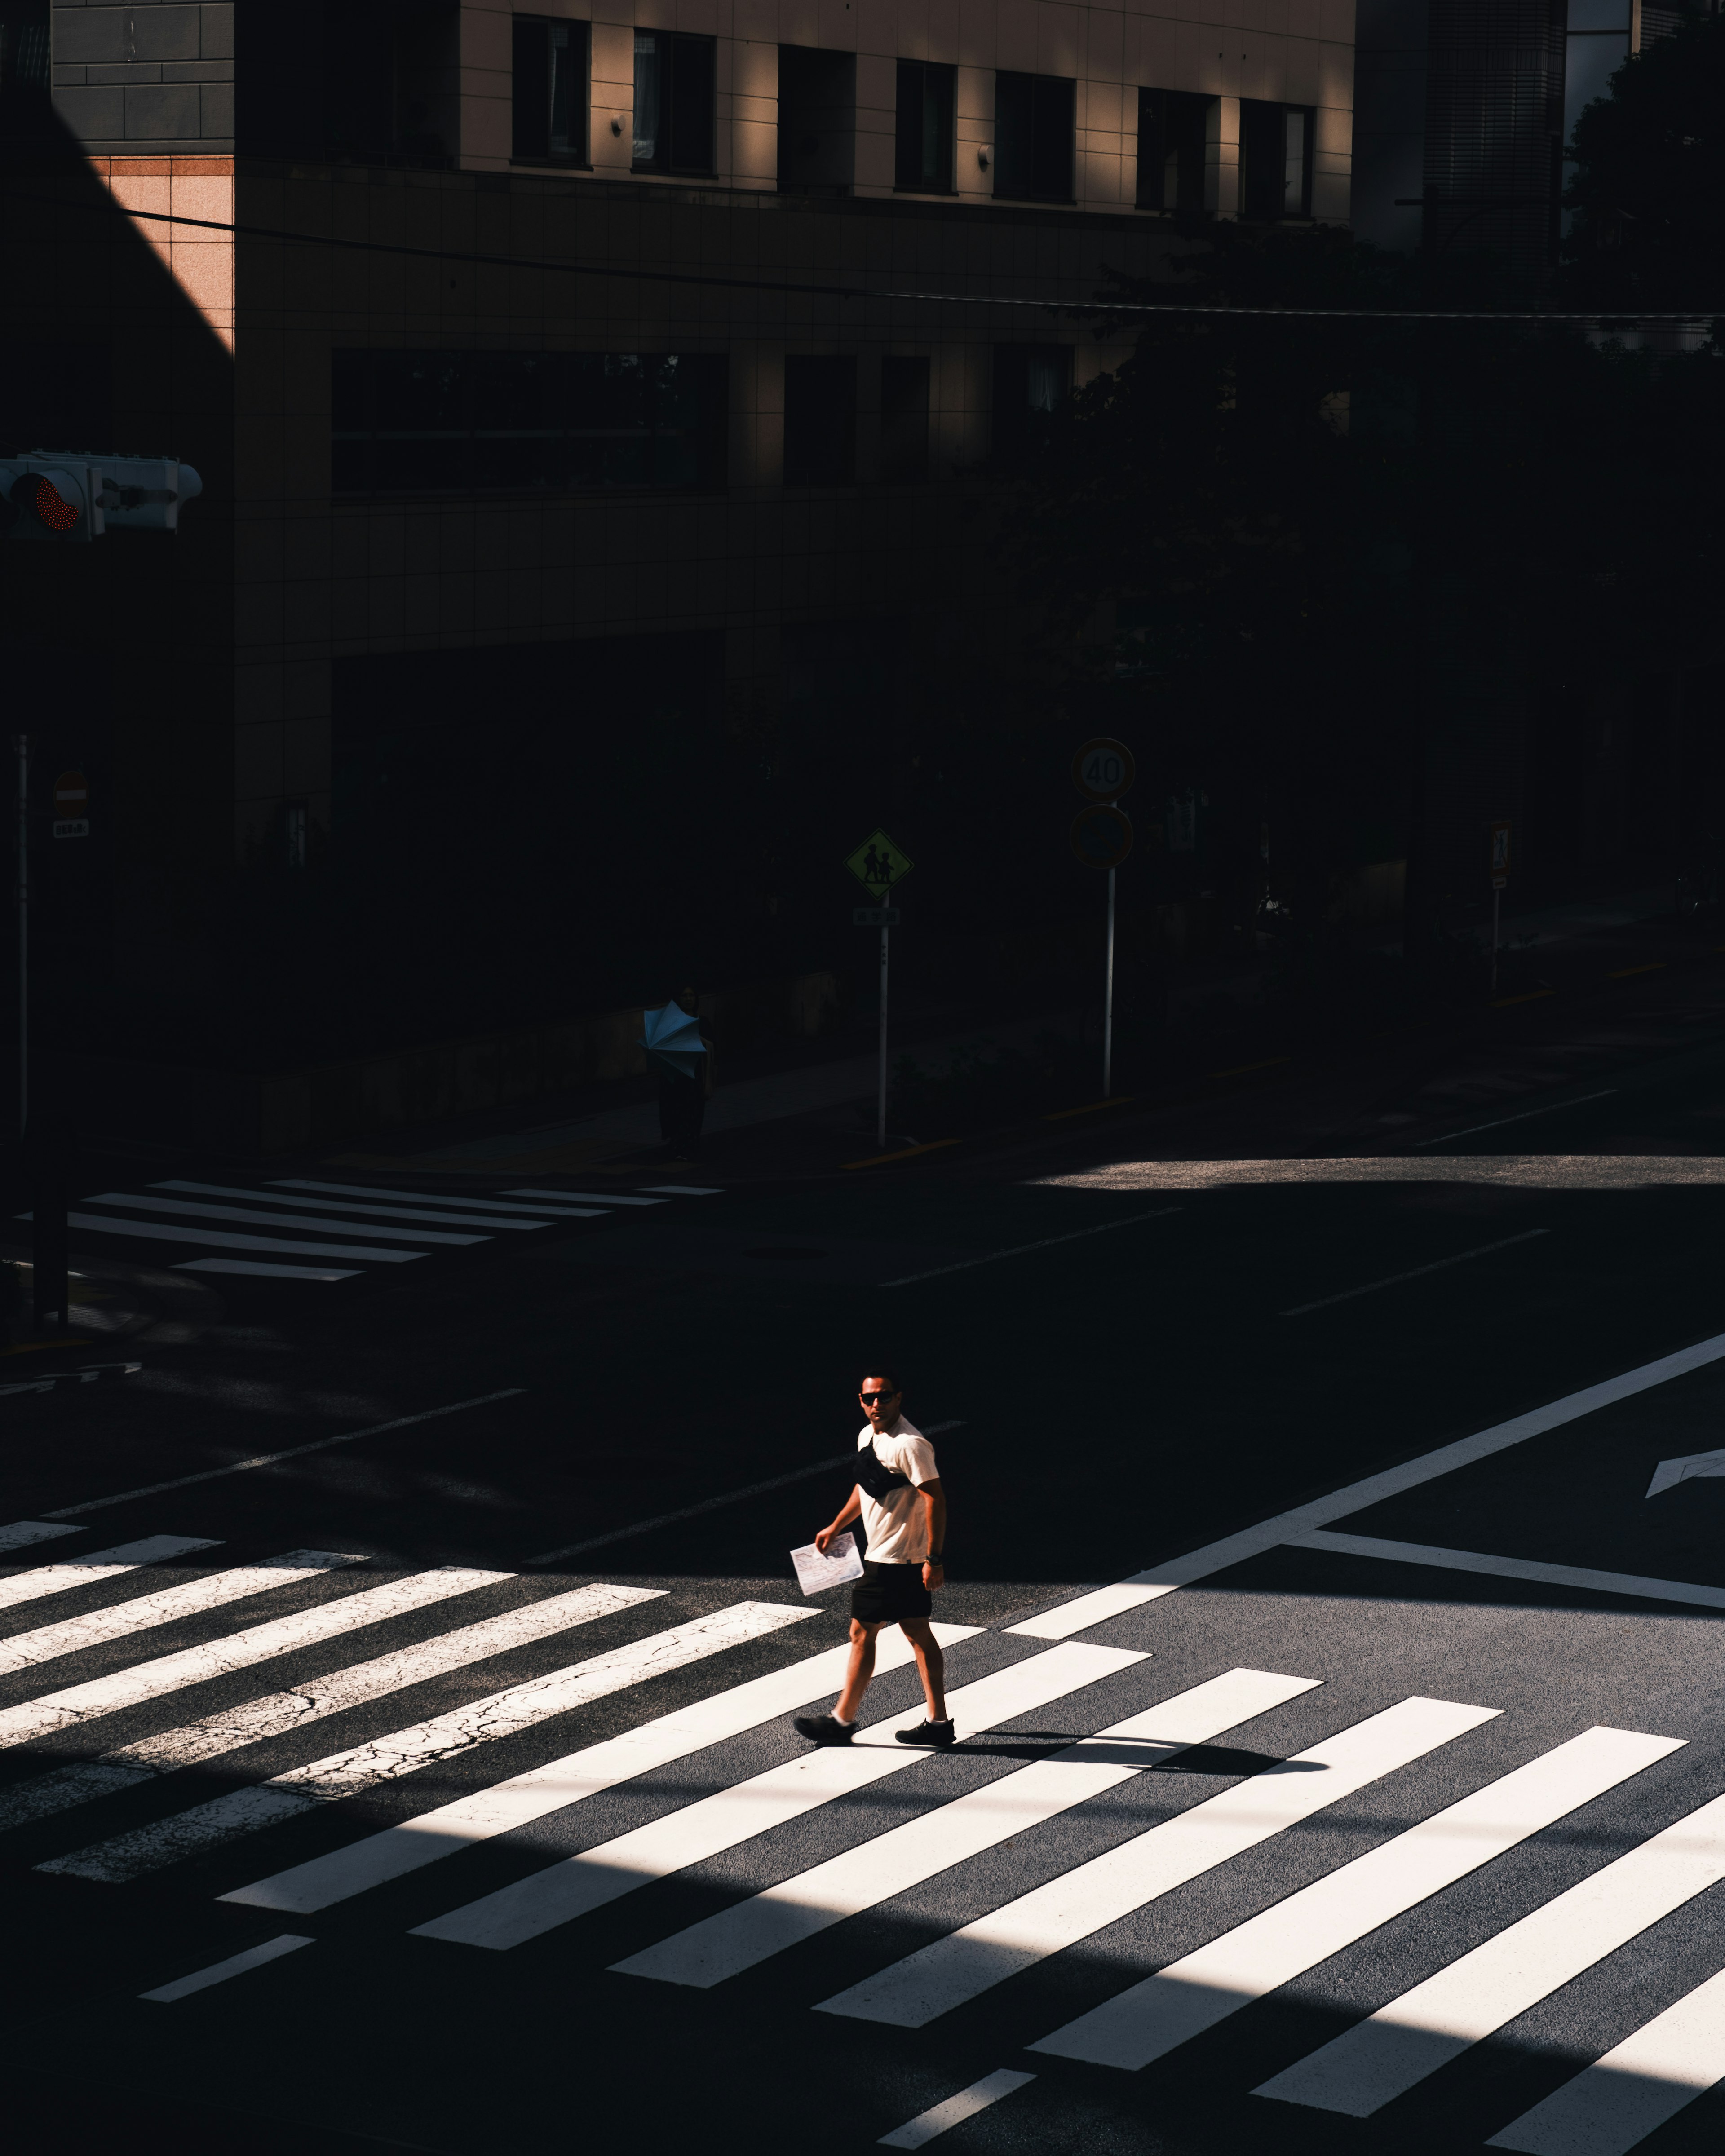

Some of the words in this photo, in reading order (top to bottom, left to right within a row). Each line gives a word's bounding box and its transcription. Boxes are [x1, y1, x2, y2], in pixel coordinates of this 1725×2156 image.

[1086, 756, 1119, 784] 40
[56, 823, 86, 835] 自転車を除く
[857, 911, 896, 922] 通学路
